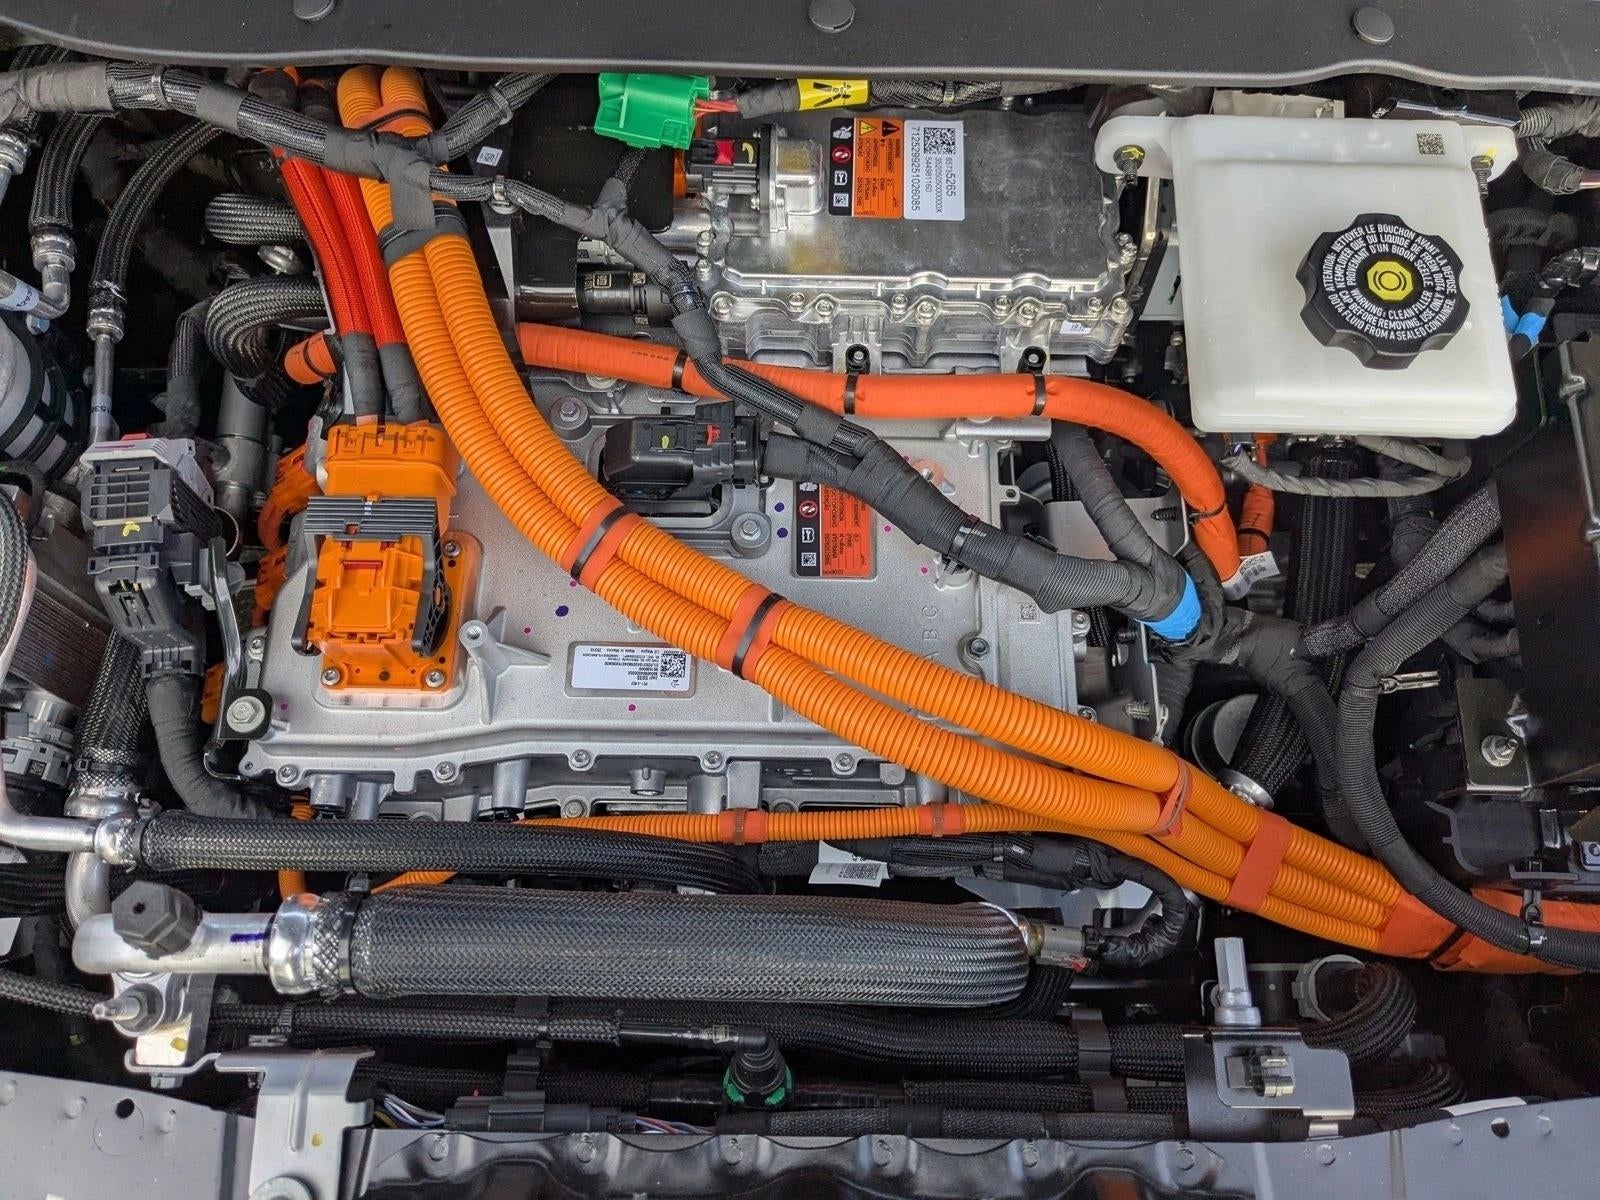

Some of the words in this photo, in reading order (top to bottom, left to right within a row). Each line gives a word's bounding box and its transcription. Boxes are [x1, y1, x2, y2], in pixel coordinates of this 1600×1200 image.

[911, 126, 921, 212] 7125299251026085
[1331, 227, 1365, 252] NETTOYER
[1365, 224, 1376, 234] LE
[1377, 224, 1416, 240] BOUCHON
[1414, 236, 1440, 255] AVANT
[1435, 254, 1448, 266] LA
[1322, 252, 1336, 291] ATTENTION:
[1345, 247, 1370, 286] PROVENANT
[1369, 243, 1389, 254] D'UN
[1391, 244, 1416, 262] BIDON
[1413, 259, 1434, 287] SCELLE
[1350, 237, 1366, 251] QUE
[1366, 233, 1378, 244] DU
[1379, 234, 1411, 248] LIQUIDE
[1410, 242, 1423, 255] DE
[1419, 251, 1440, 272] FREIN
[1433, 273, 1446, 290] DOT4
[1441, 266, 1457, 294] DEPOSE
[1328, 293, 1346, 313] DOT4
[1341, 309, 1365, 329] FLUID
[1363, 323, 1389, 340] FROM
[1389, 330, 1395, 340] A
[1395, 326, 1427, 341] SEALED
[1424, 298, 1456, 333] CONTAINER.
[1338, 290, 1354, 303] CAP
[1348, 302, 1378, 326] BEFORE
[1377, 317, 1423, 330] REMOVING.
[1419, 307, 1436, 323] USE
[1429, 292, 1445, 312] ONLY
[1388, 307, 1415, 320] CLEAN
[1411, 290, 1433, 314] FILLER
